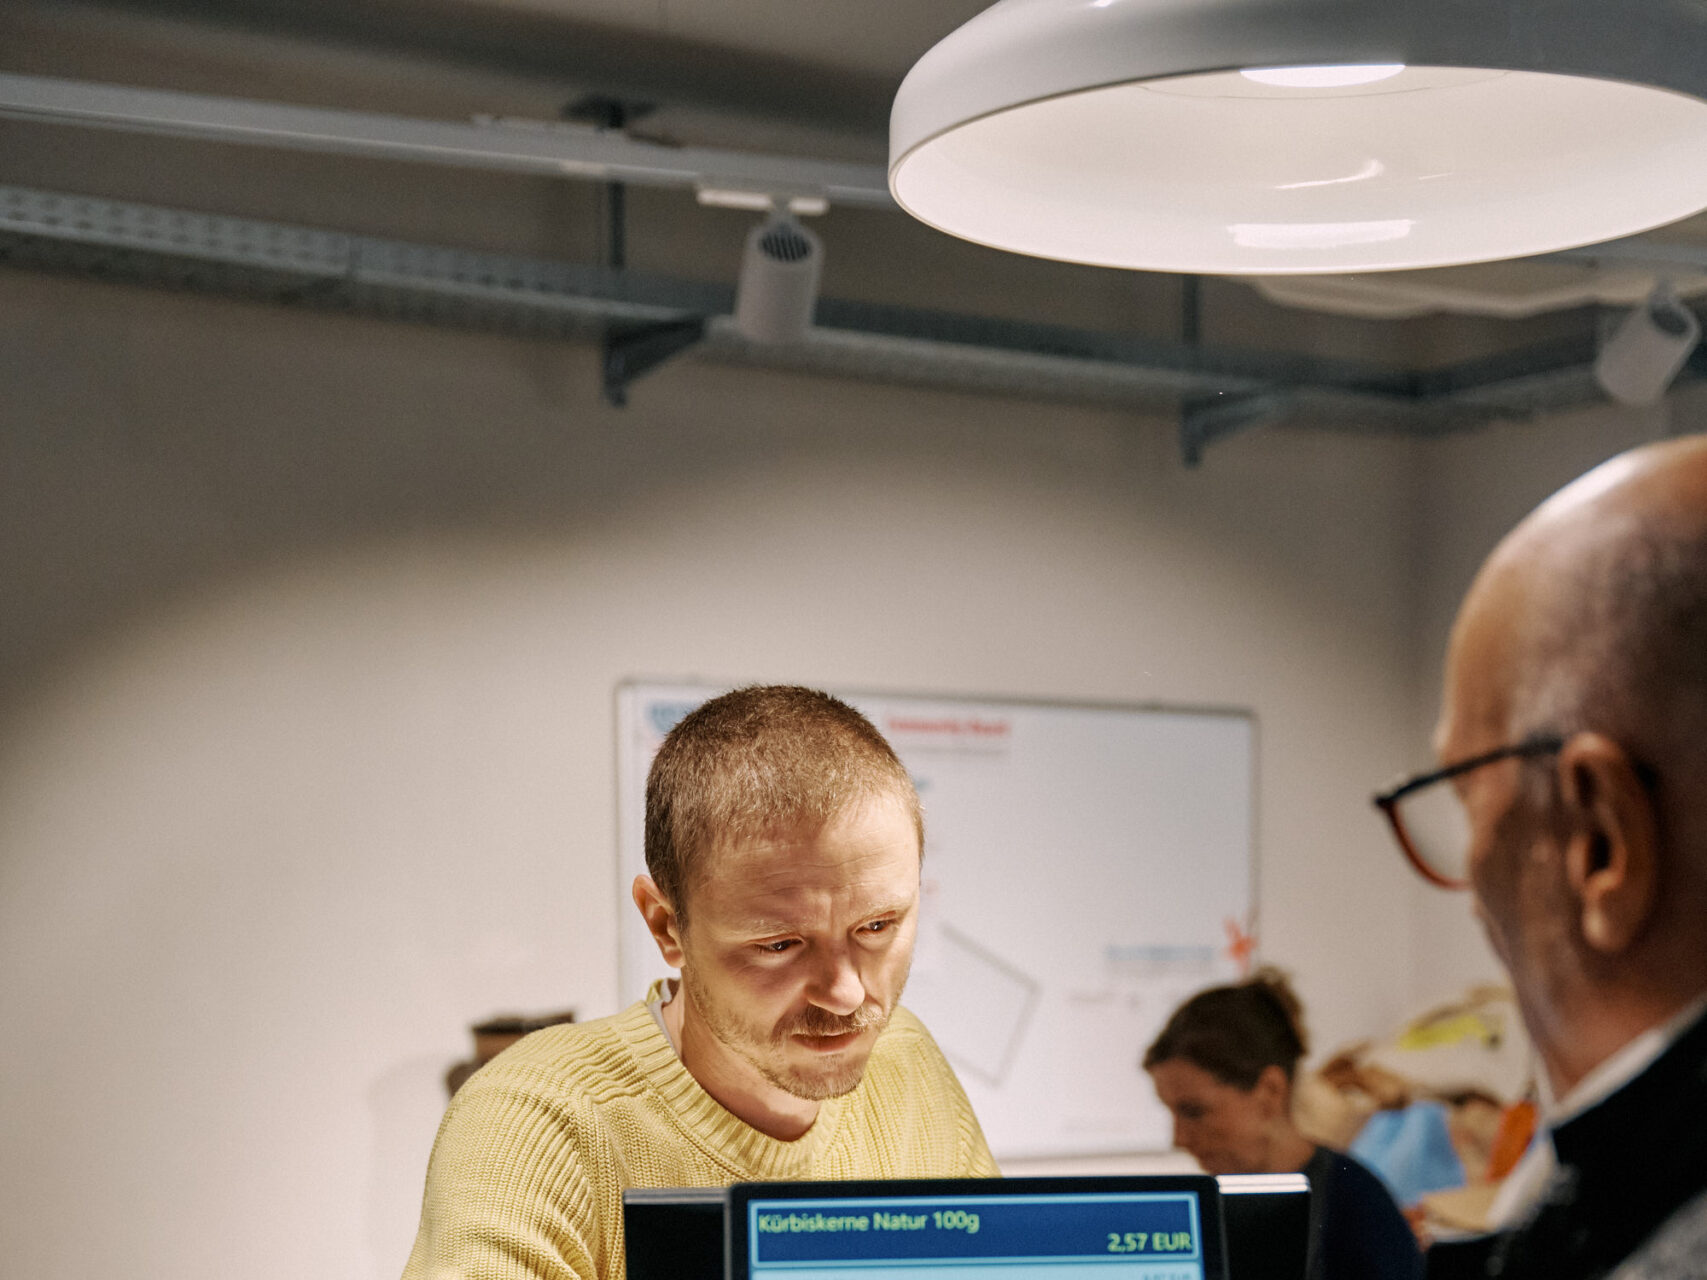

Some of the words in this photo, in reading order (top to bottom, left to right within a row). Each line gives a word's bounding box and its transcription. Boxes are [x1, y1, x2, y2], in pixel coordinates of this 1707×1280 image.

[759, 1213, 869, 1233] Kürbiskerne
[873, 1211, 928, 1231] Natur
[933, 1210, 980, 1234] 100g
[1107, 1232, 1148, 1253] 2,57
[1152, 1231, 1192, 1252] EUR
